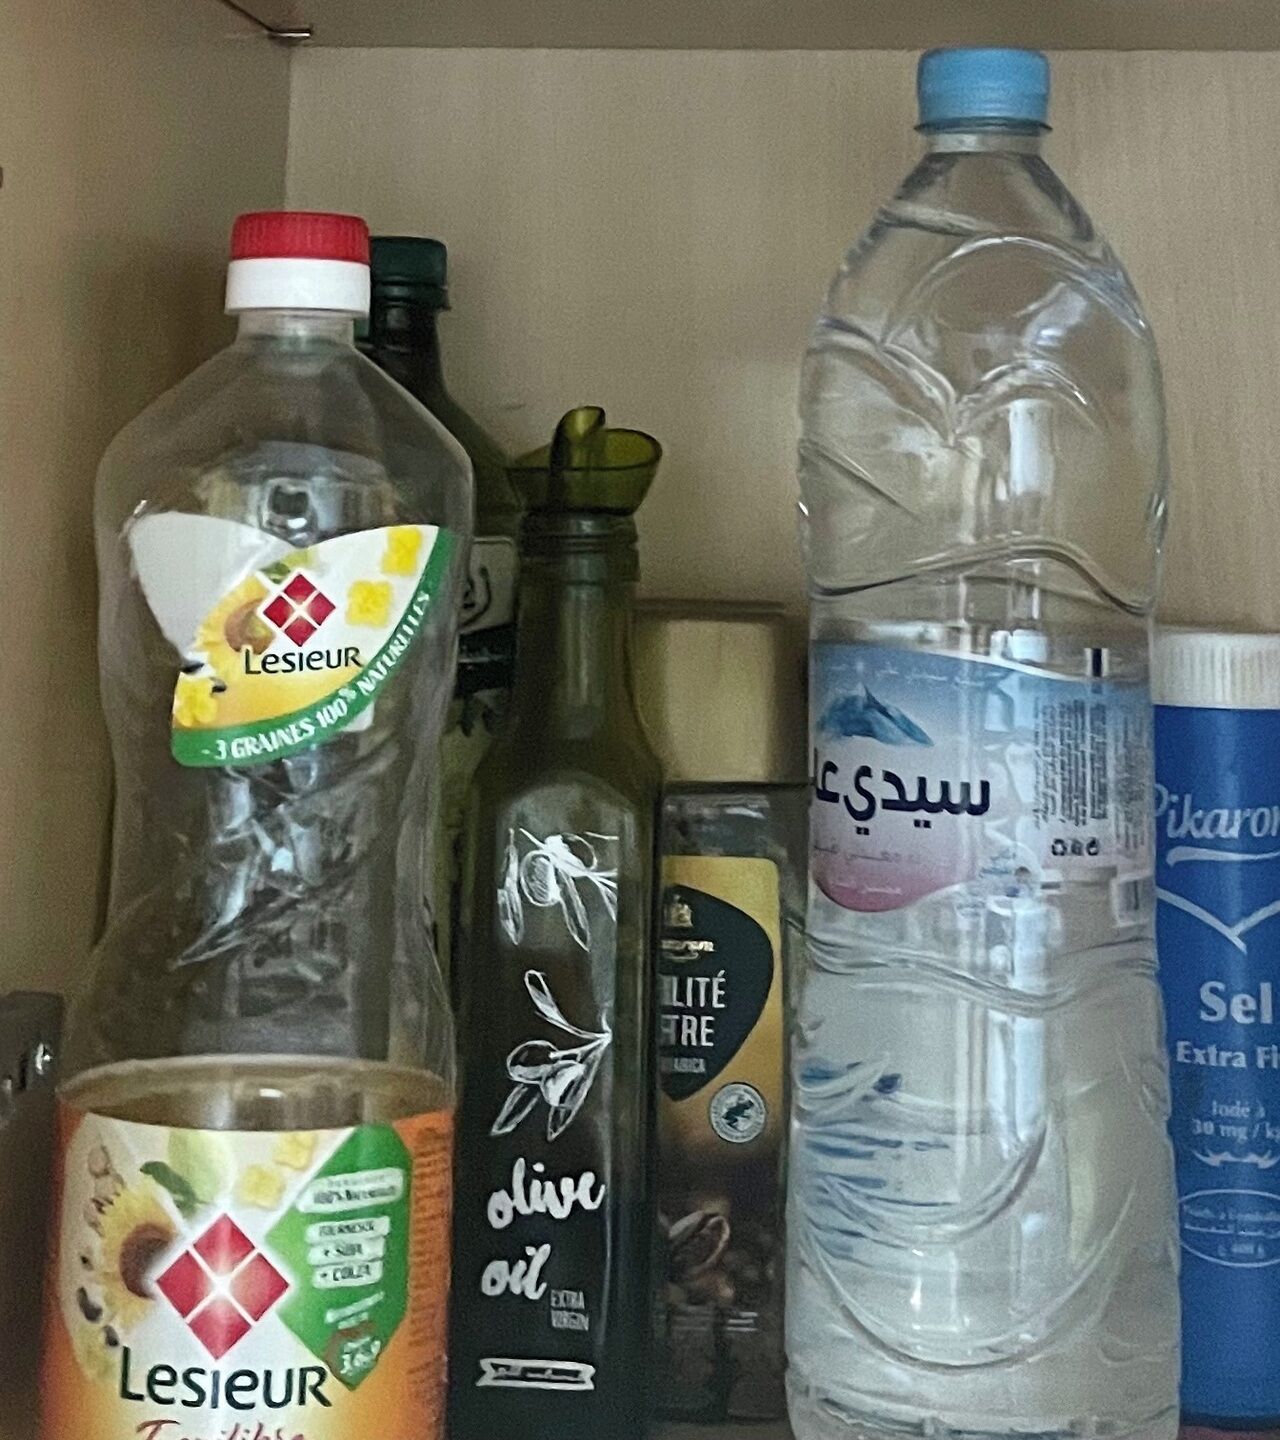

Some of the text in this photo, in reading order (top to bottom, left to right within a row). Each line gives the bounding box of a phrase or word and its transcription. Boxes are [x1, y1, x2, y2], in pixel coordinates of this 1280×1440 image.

[215, 740, 227, 760] 3
[231, 717, 316, 758] GRAINES
[316, 687, 357, 728] 100%
[843, 765, 990, 836] سيدي
[660, 970, 726, 1009] LITÉ
[1199, 981, 1273, 1024] Sel
[662, 1014, 716, 1047] TRE
[1176, 1041, 1247, 1068] Extra
[1192, 1119, 1214, 1136] 30
[1220, 1124, 1249, 1143] mg
[487, 1158, 606, 1229] olive
[482, 1244, 551, 1300] oil
